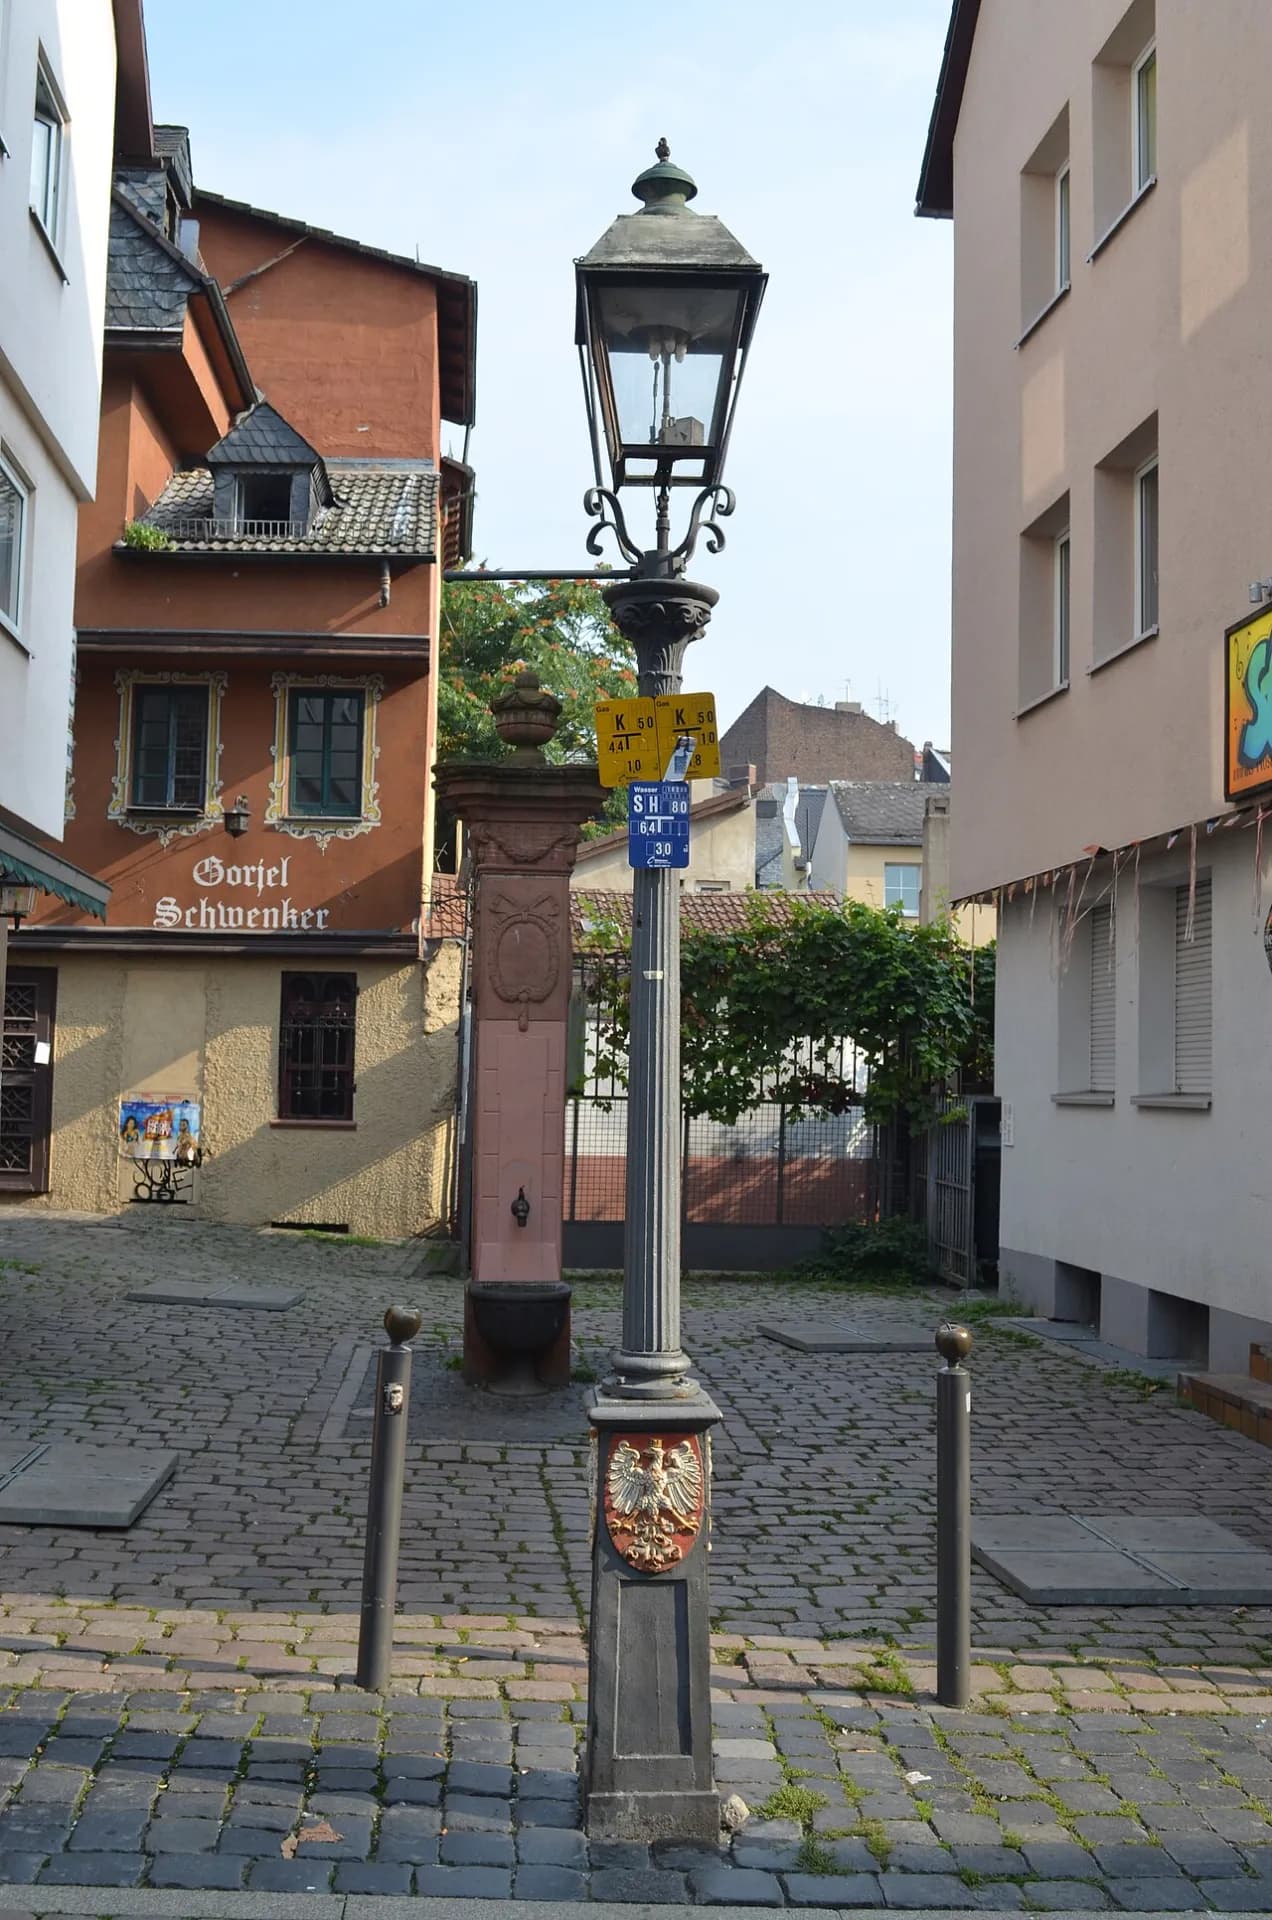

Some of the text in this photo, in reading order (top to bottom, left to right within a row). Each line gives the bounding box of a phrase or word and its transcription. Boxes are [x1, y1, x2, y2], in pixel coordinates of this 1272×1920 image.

[596, 705, 610, 713] Gas
[656, 700, 669, 708] Gas
[615, 713, 654, 731] K 50
[675, 708, 714, 726] K 50
[633, 785, 658, 793] Wasser
[672, 800, 687, 814] 80
[192, 855, 292, 897] Gorjel
[152, 896, 330, 930] Schwenker
